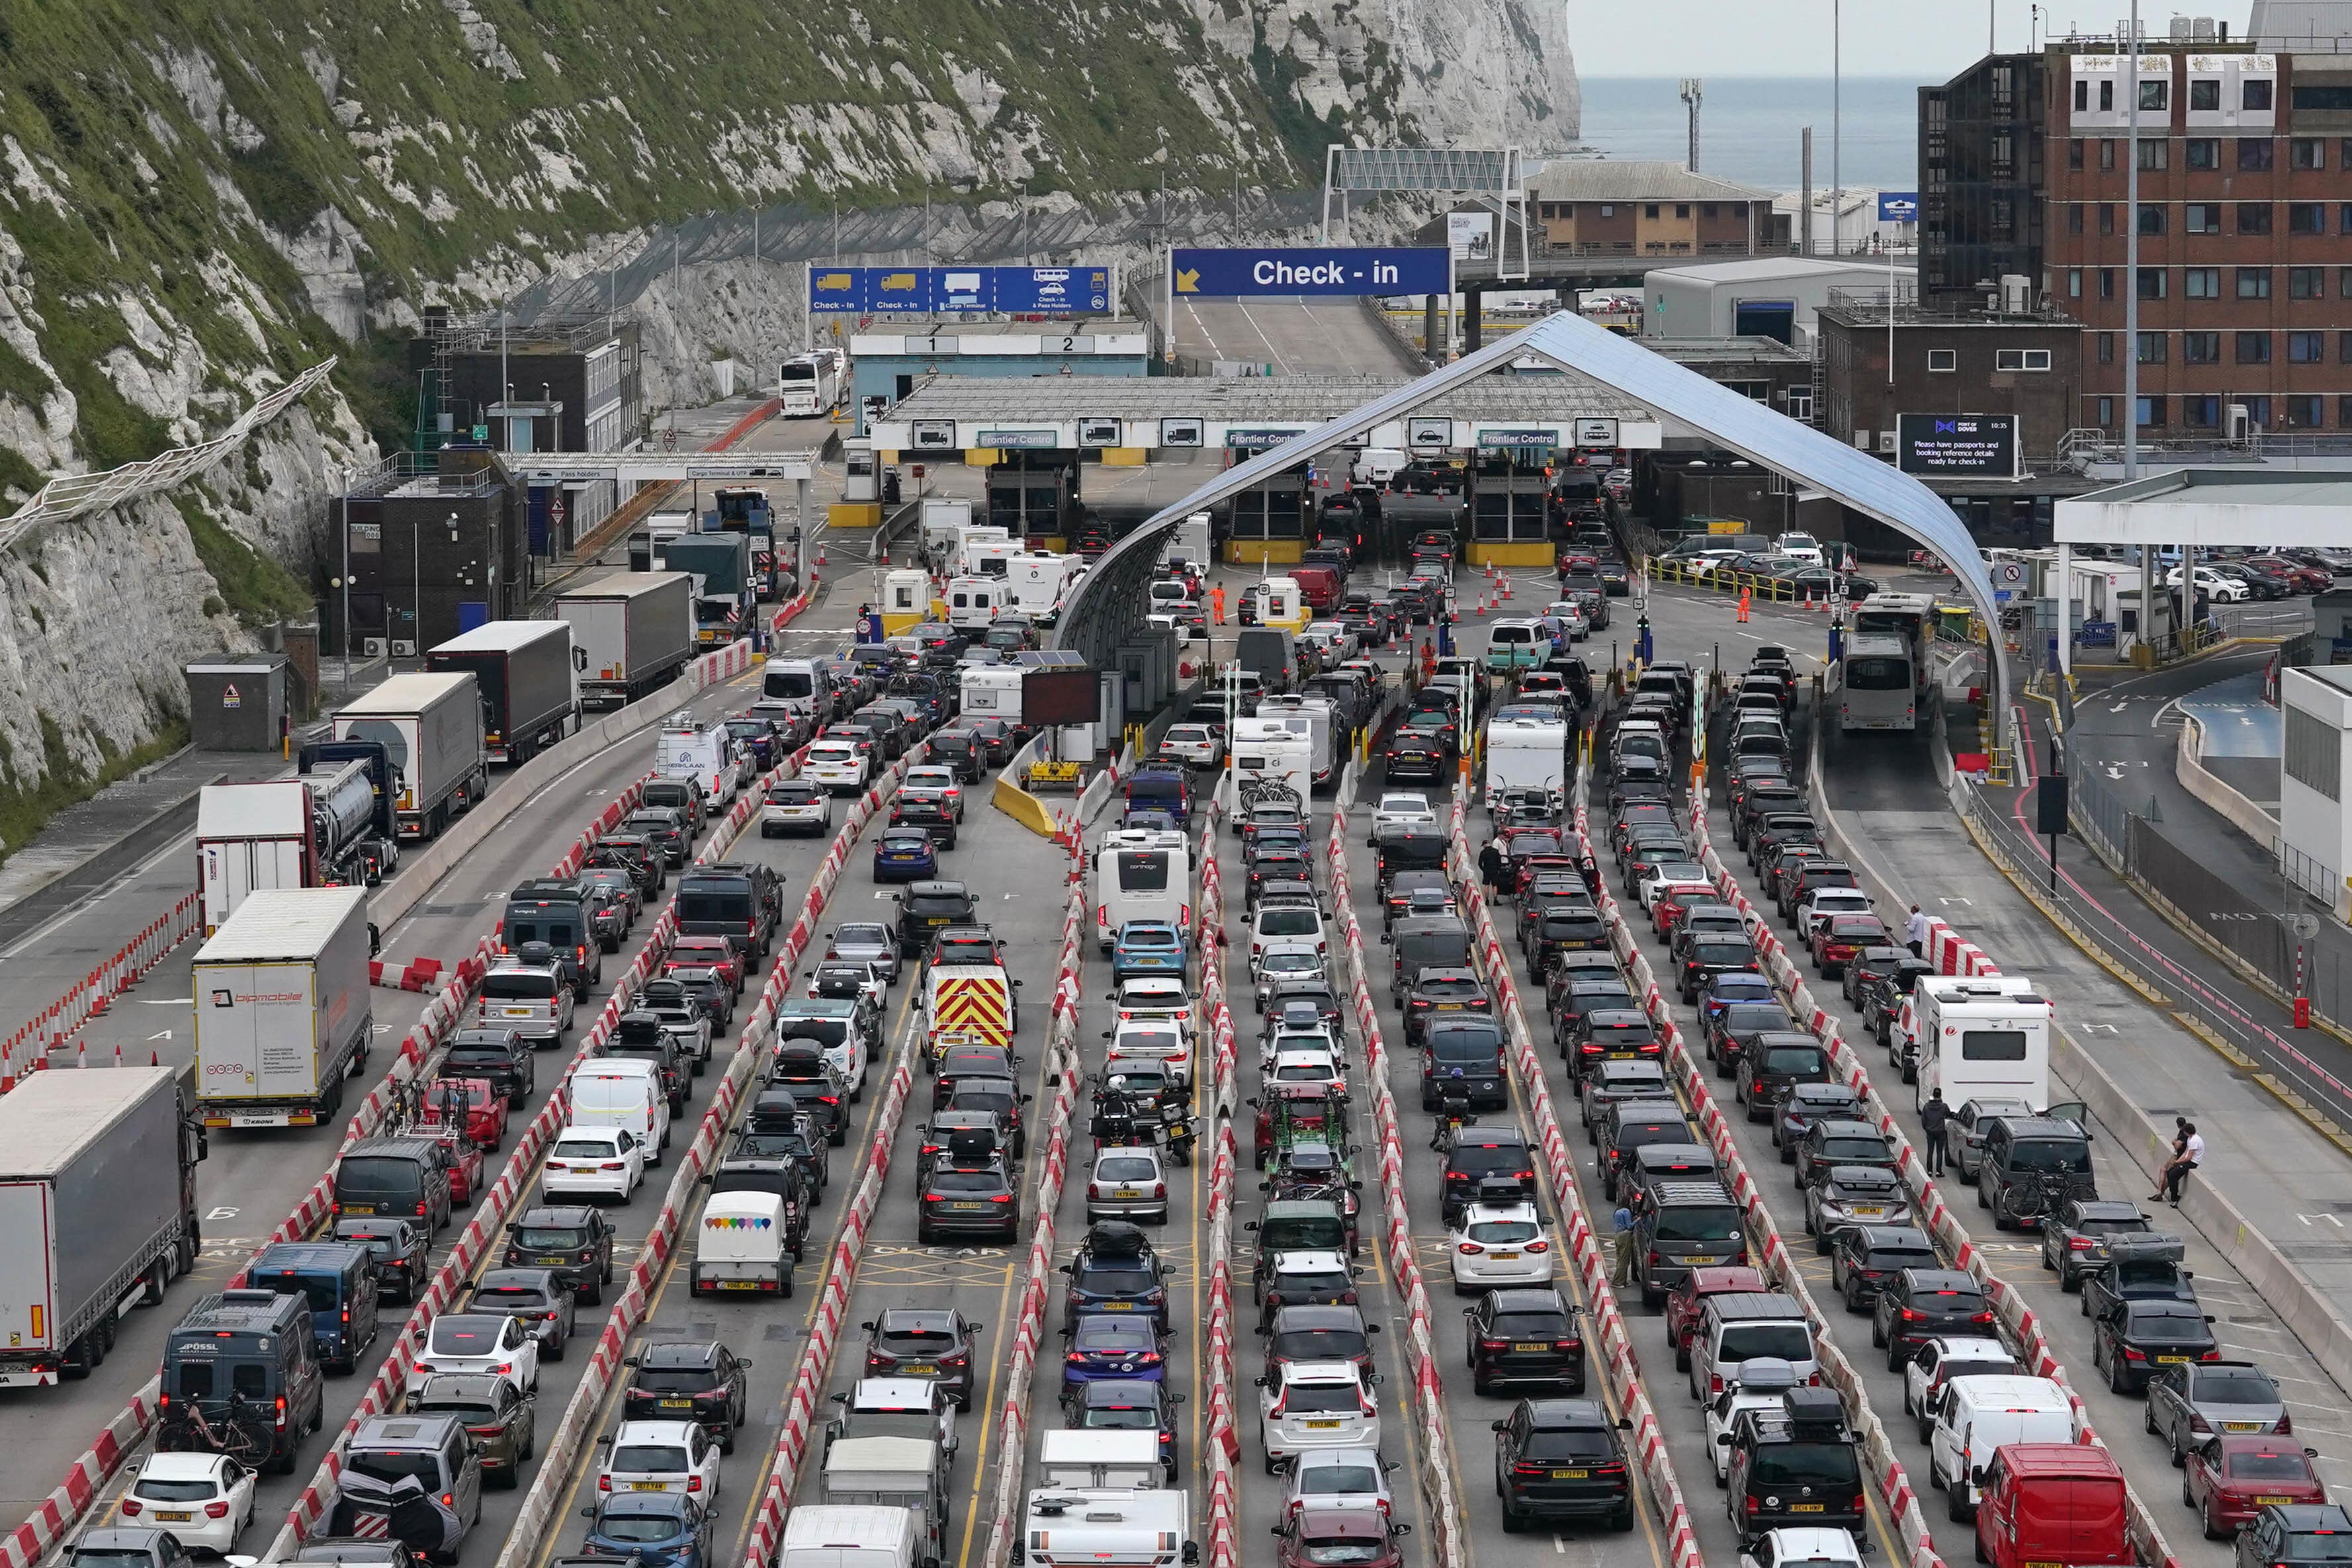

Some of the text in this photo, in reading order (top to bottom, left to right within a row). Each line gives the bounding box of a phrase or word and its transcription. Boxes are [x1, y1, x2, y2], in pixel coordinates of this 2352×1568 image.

[1253, 261, 1345, 284] Check
[1373, 261, 1399, 284] in
[929, 338, 935, 351] 1
[1063, 338, 1073, 351] 2
[981, 435, 1053, 445] Frontier Control
[1230, 435, 1266, 443] Frontier
[1483, 434, 1555, 443] Frontier Control
[236, 993, 302, 1003] bipmobile
[146, 1029, 173, 1040] A
[206, 1206, 240, 1220] B
